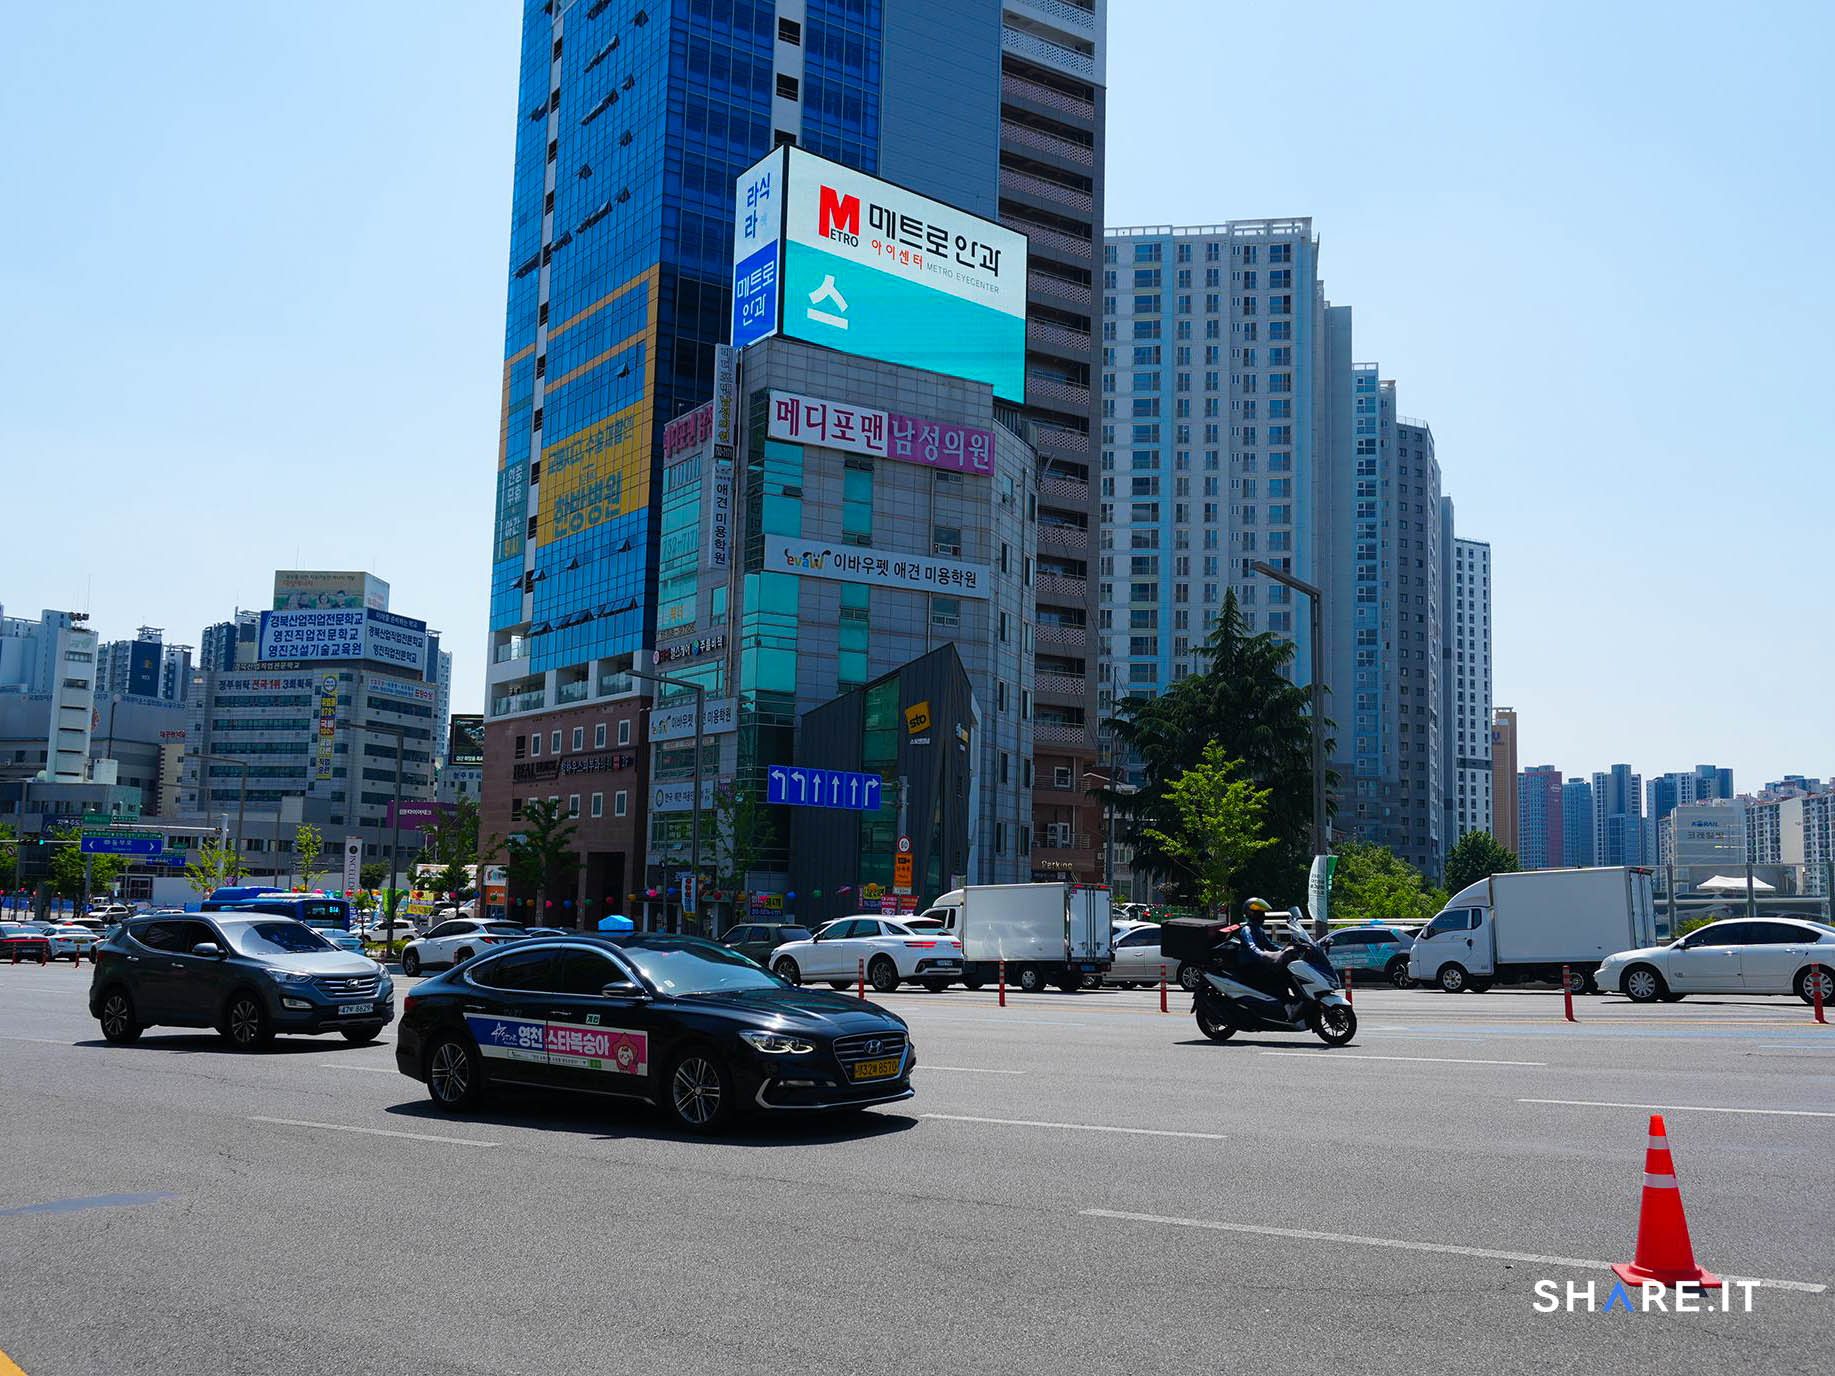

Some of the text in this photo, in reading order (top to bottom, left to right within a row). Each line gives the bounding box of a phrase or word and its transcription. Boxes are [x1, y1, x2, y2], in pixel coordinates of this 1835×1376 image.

[746, 172, 770, 207] 라식
[745, 209, 766, 239] 라
[871, 239, 924, 270] 아이센터
[737, 260, 774, 299] 메트로
[926, 262, 1000, 294] METRO EYECENTER
[743, 293, 767, 326] 안과
[806, 274, 848, 330] 스
[775, 397, 989, 470] 메디포맨 남성의원
[713, 513, 727, 566] 미용학원
[834, 553, 889, 577] 이바우펫
[894, 561, 920, 580] 애견
[925, 566, 977, 589] 미용학원
[270, 612, 363, 628] 경북산업직업전문학교
[273, 628, 359, 643] 영진직업전문학교
[268, 643, 362, 657] 영진건설기술교육원
[372, 643, 417, 664] 영진직업전문학교
[707, 707, 731, 725] 미용학원
[909, 713, 927, 728] sto
[1041, 860, 1073, 870] Parking
[518, 1025, 543, 1048] 영천
[547, 1029, 609, 1056] 스타복숭아
[878, 1060, 898, 1074] 8570
